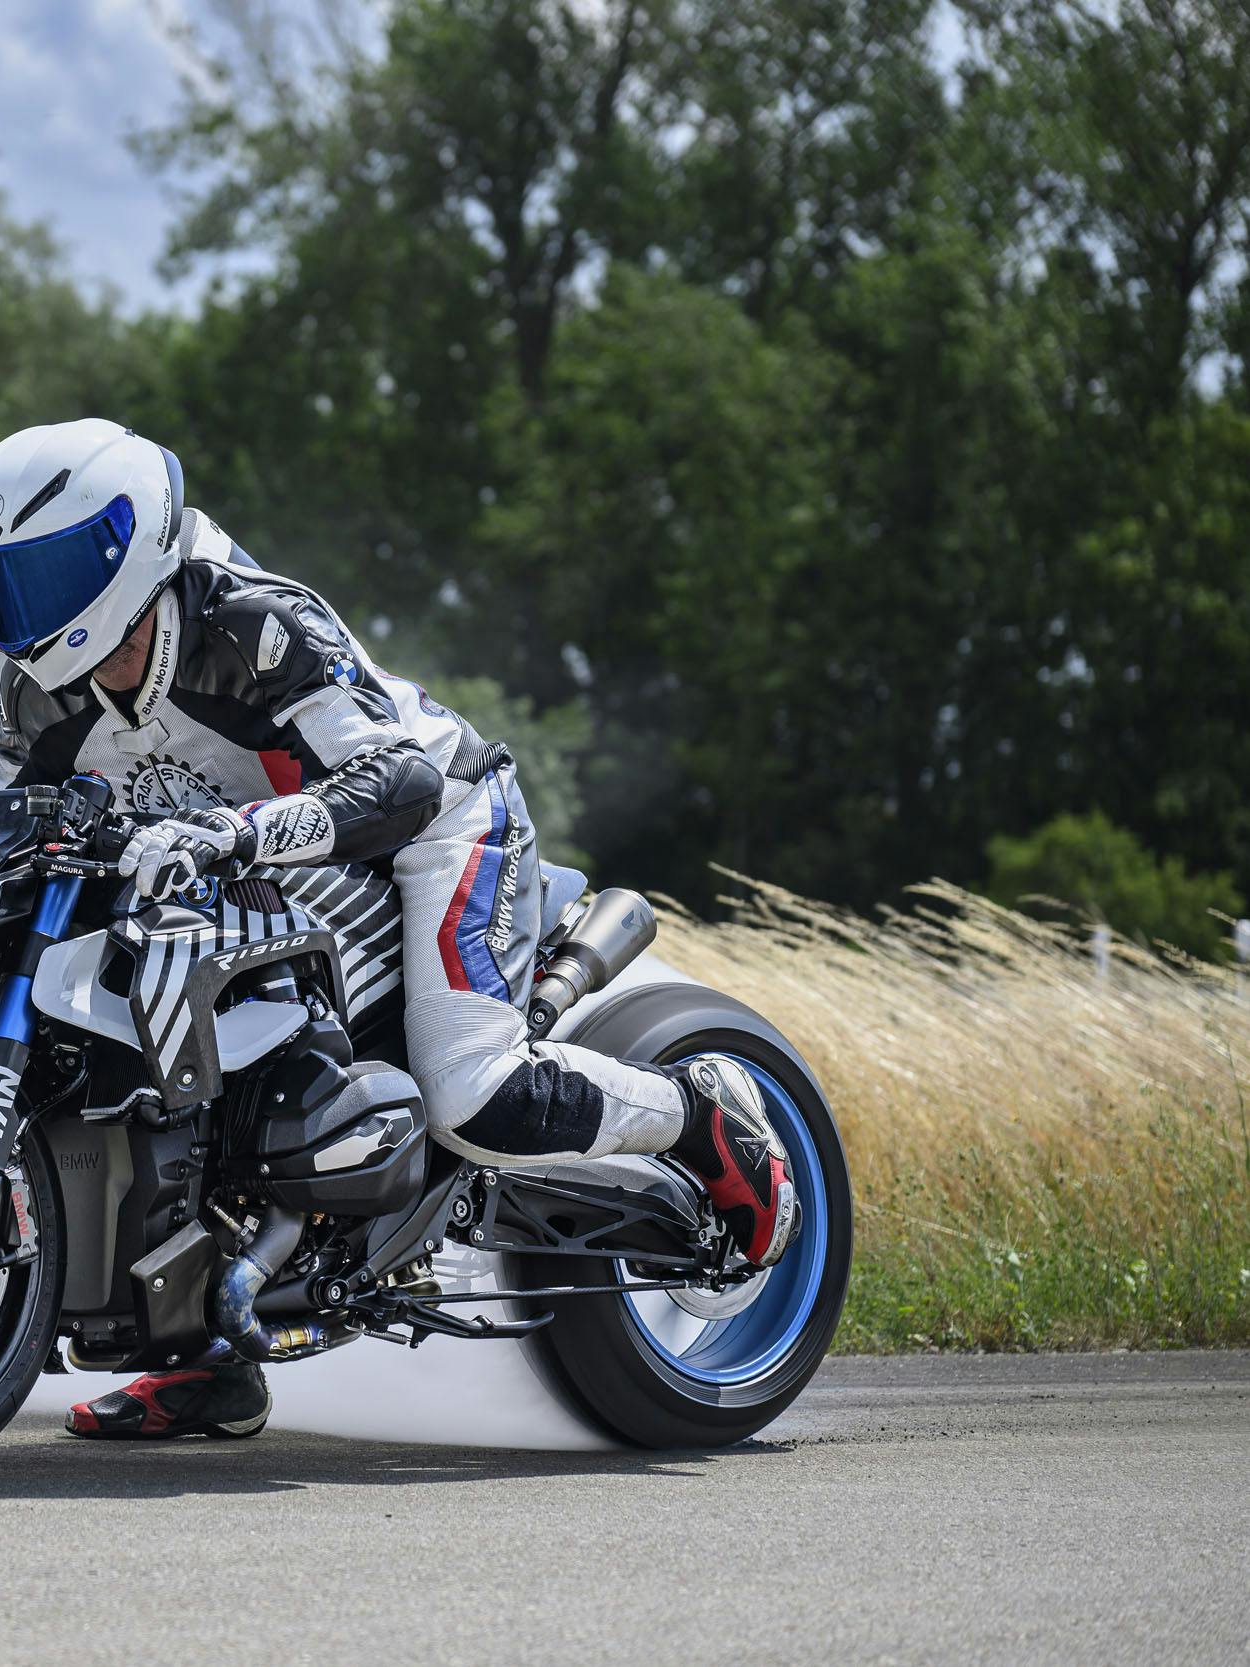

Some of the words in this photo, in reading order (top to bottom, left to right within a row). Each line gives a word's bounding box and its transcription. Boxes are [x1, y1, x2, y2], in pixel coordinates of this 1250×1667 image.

[157, 488, 171, 548] BoxerCup
[129, 611, 141, 626] BMW
[269, 623, 286, 668] RACE
[326, 652, 354, 675] BMW
[141, 686, 161, 716] BMW
[154, 630, 172, 687] Motorrad
[50, 863, 84, 876] MAGURA
[491, 896, 513, 952] BMW
[60, 1151, 100, 1170] BMW
[11, 1190, 30, 1237] BMW
